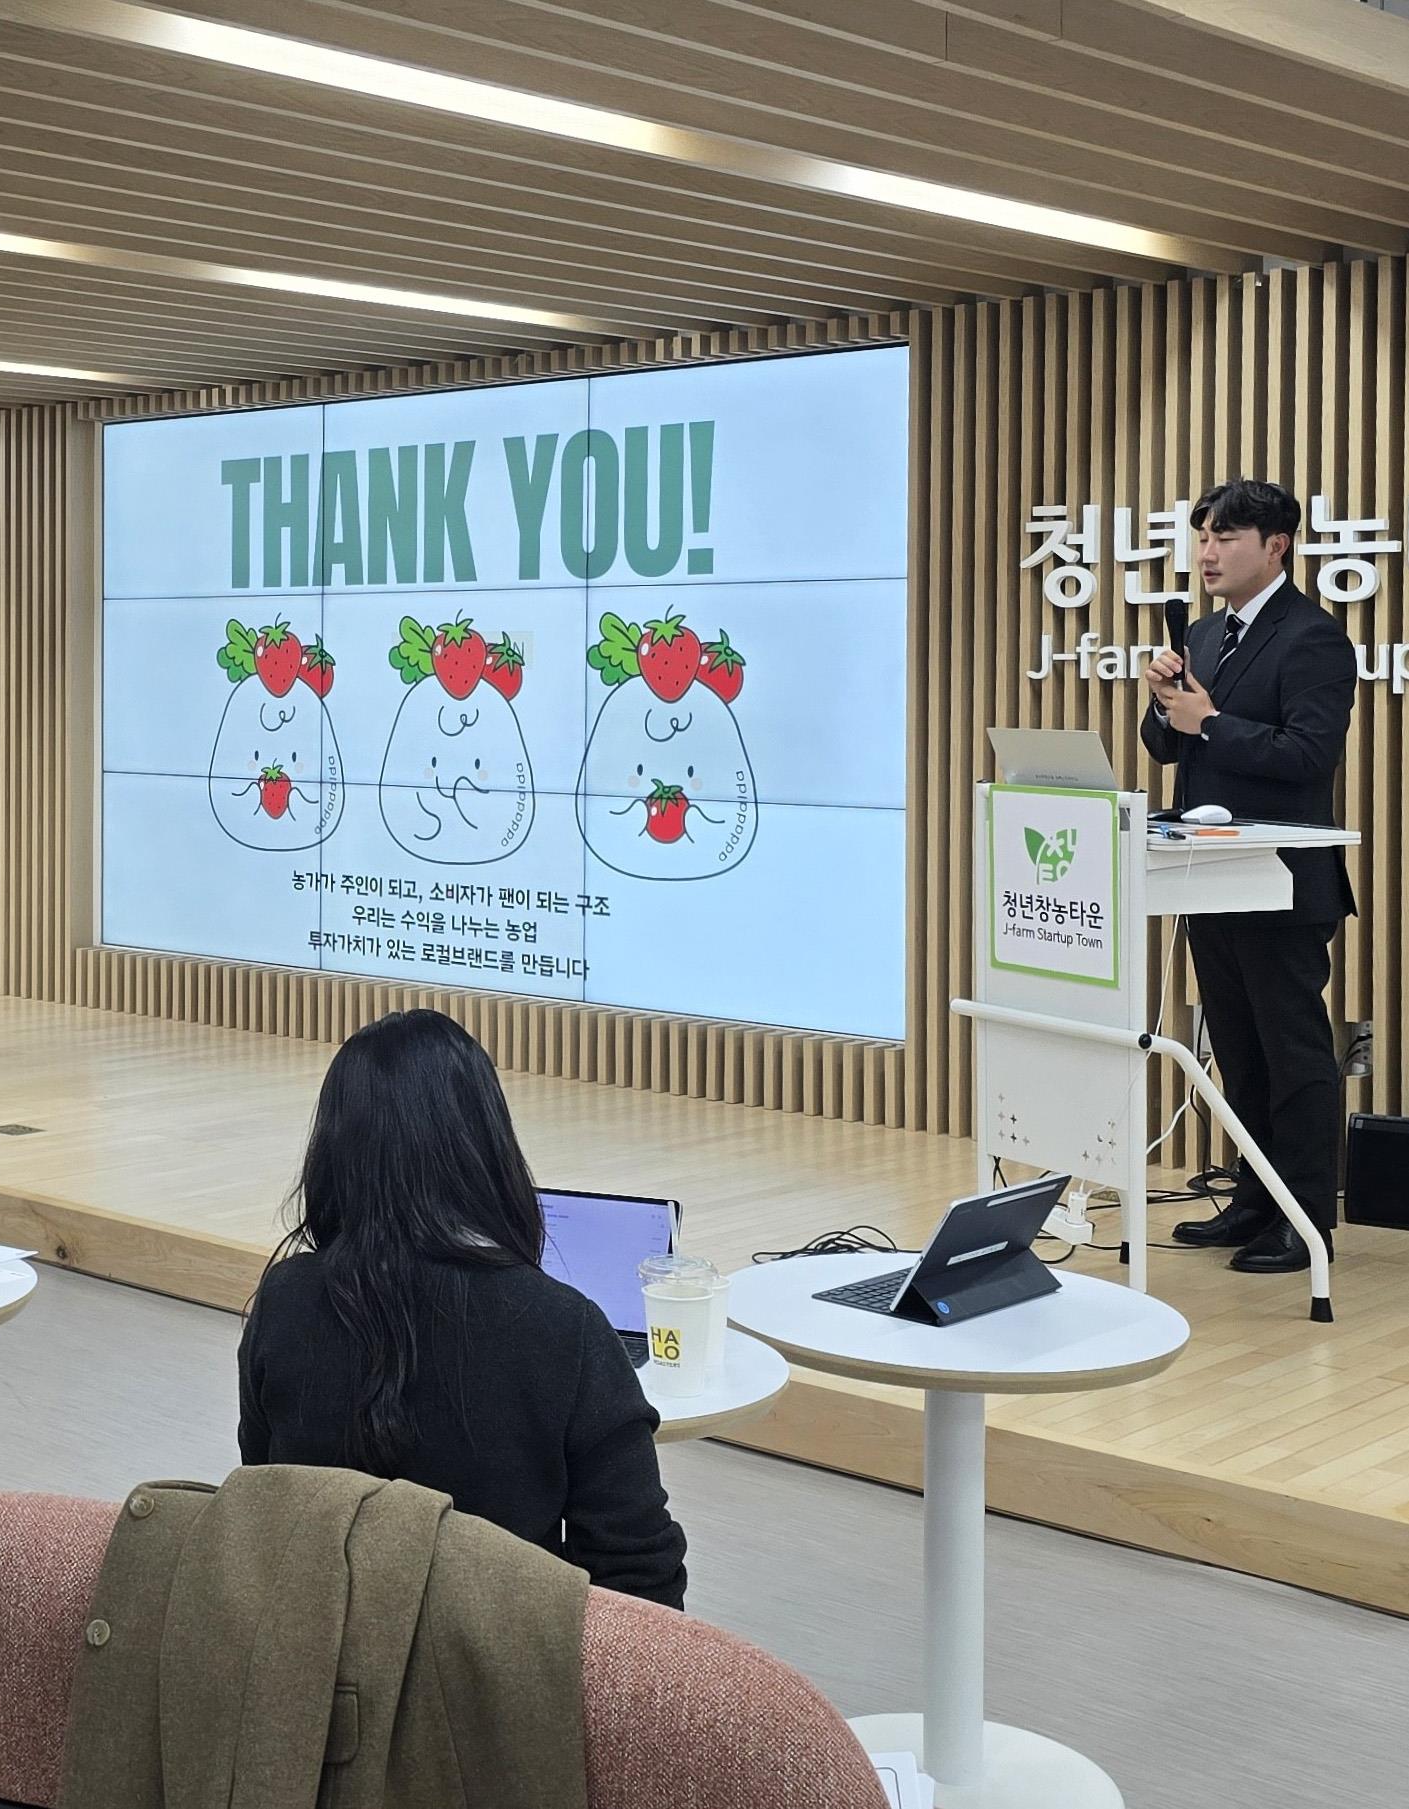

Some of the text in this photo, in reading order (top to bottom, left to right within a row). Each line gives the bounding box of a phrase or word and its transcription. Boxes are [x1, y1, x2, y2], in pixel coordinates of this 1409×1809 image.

[221, 420, 715, 588] THANK YOU!
[1026, 632, 1172, 679] J-far
[500, 762, 526, 847] addadalda
[718, 770, 748, 861] addadalda
[291, 869, 611, 917] 농가가 주인이 되고, 소비자가 팬이 되는 구조
[1002, 890, 1104, 929] 청년창농타운
[352, 905, 537, 944] 우리는 수익을 나누는 농업
[1003, 922, 1103, 949] J-farm Startup Town
[308, 930, 590, 981] 투자가치가 있는 로컬브랜드를 만듭니다
[651, 1326, 679, 1345] HA
[652, 1342, 680, 1360] LO
